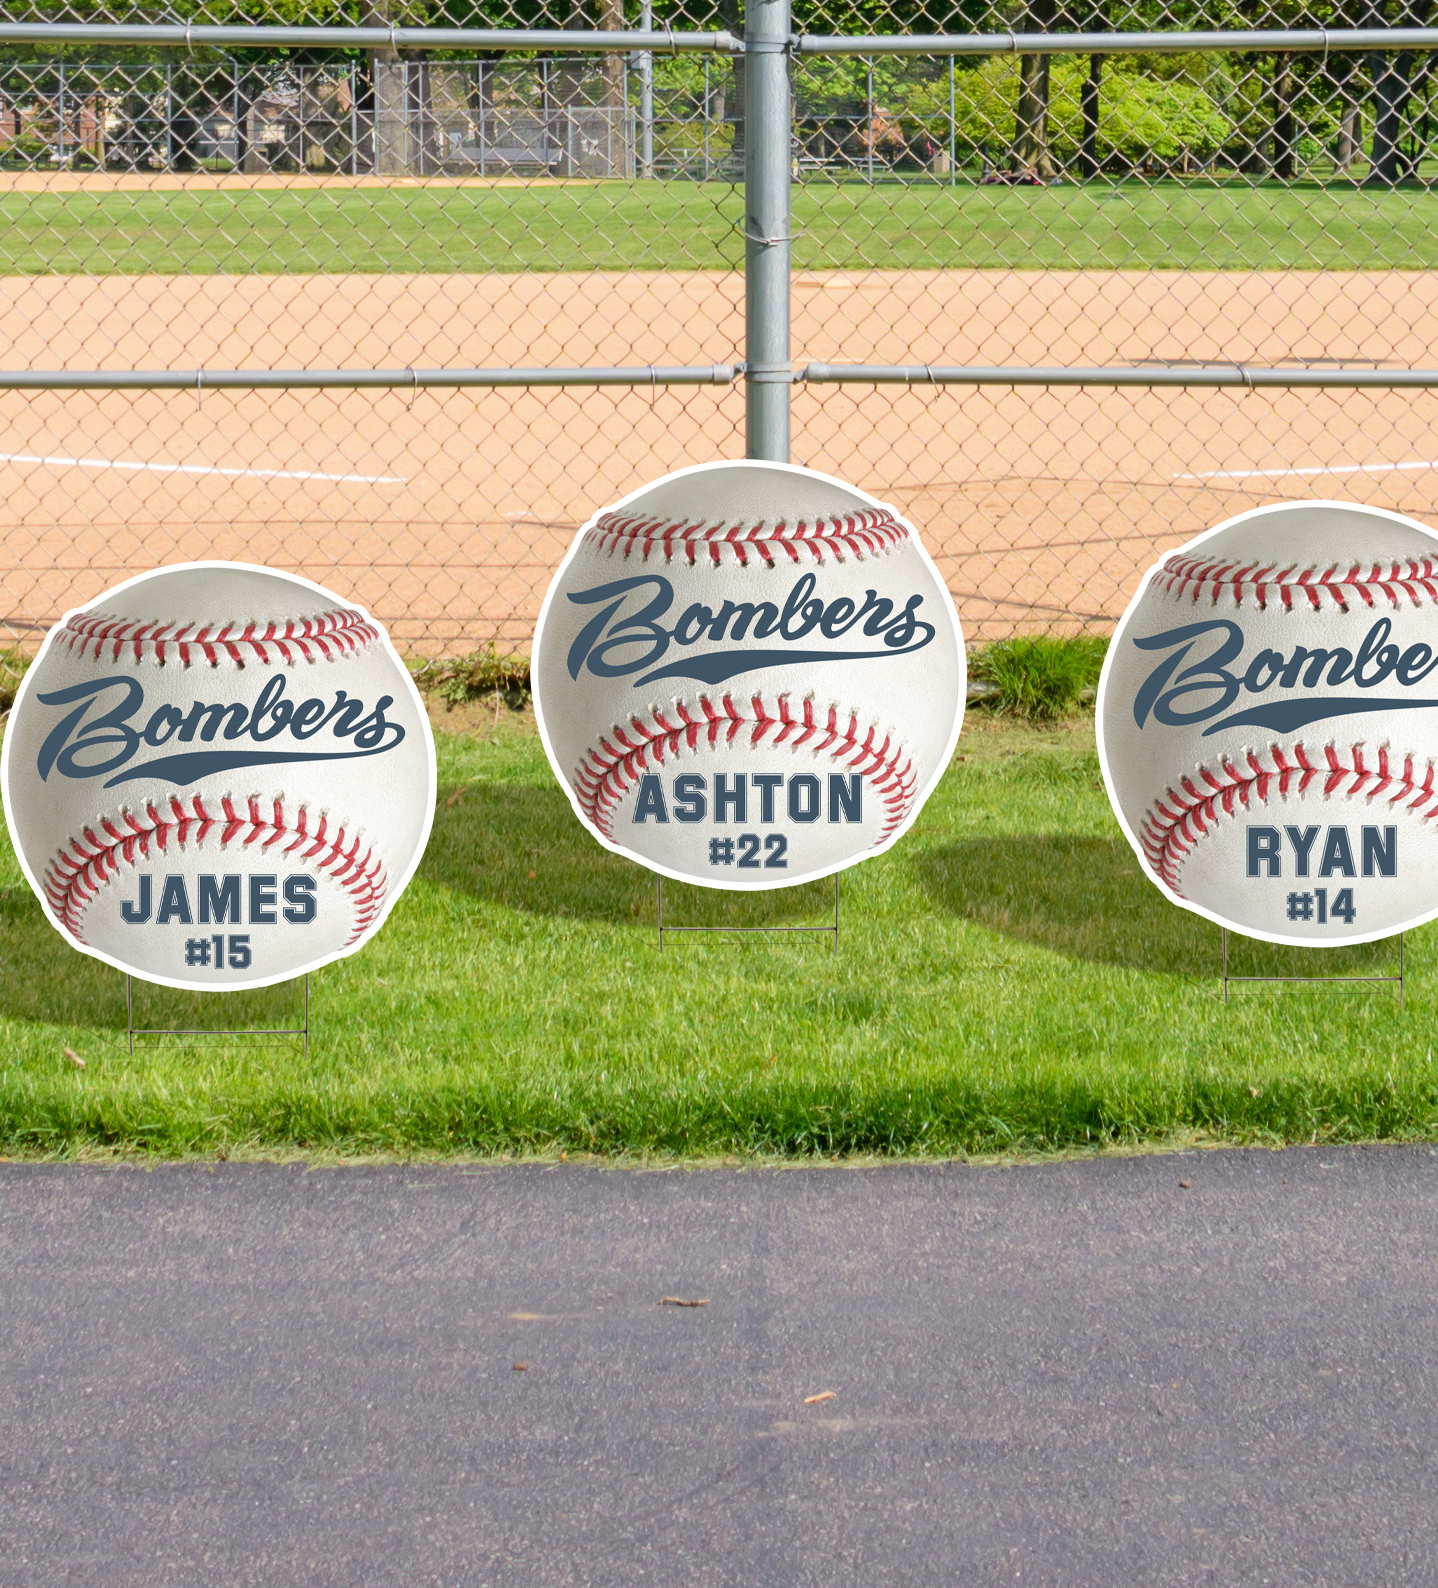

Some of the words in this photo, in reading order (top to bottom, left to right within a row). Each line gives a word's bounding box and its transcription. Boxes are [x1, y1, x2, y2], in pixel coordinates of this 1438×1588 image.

[566, 573, 935, 688] Bombers
[37, 674, 405, 789] Bombers
[632, 772, 863, 824] ASHTON
[709, 833, 788, 869] #22
[1246, 825, 1397, 878] RYAN
[120, 873, 318, 925] JAMES
[1287, 887, 1357, 924] #14
[185, 934, 252, 970] #15
